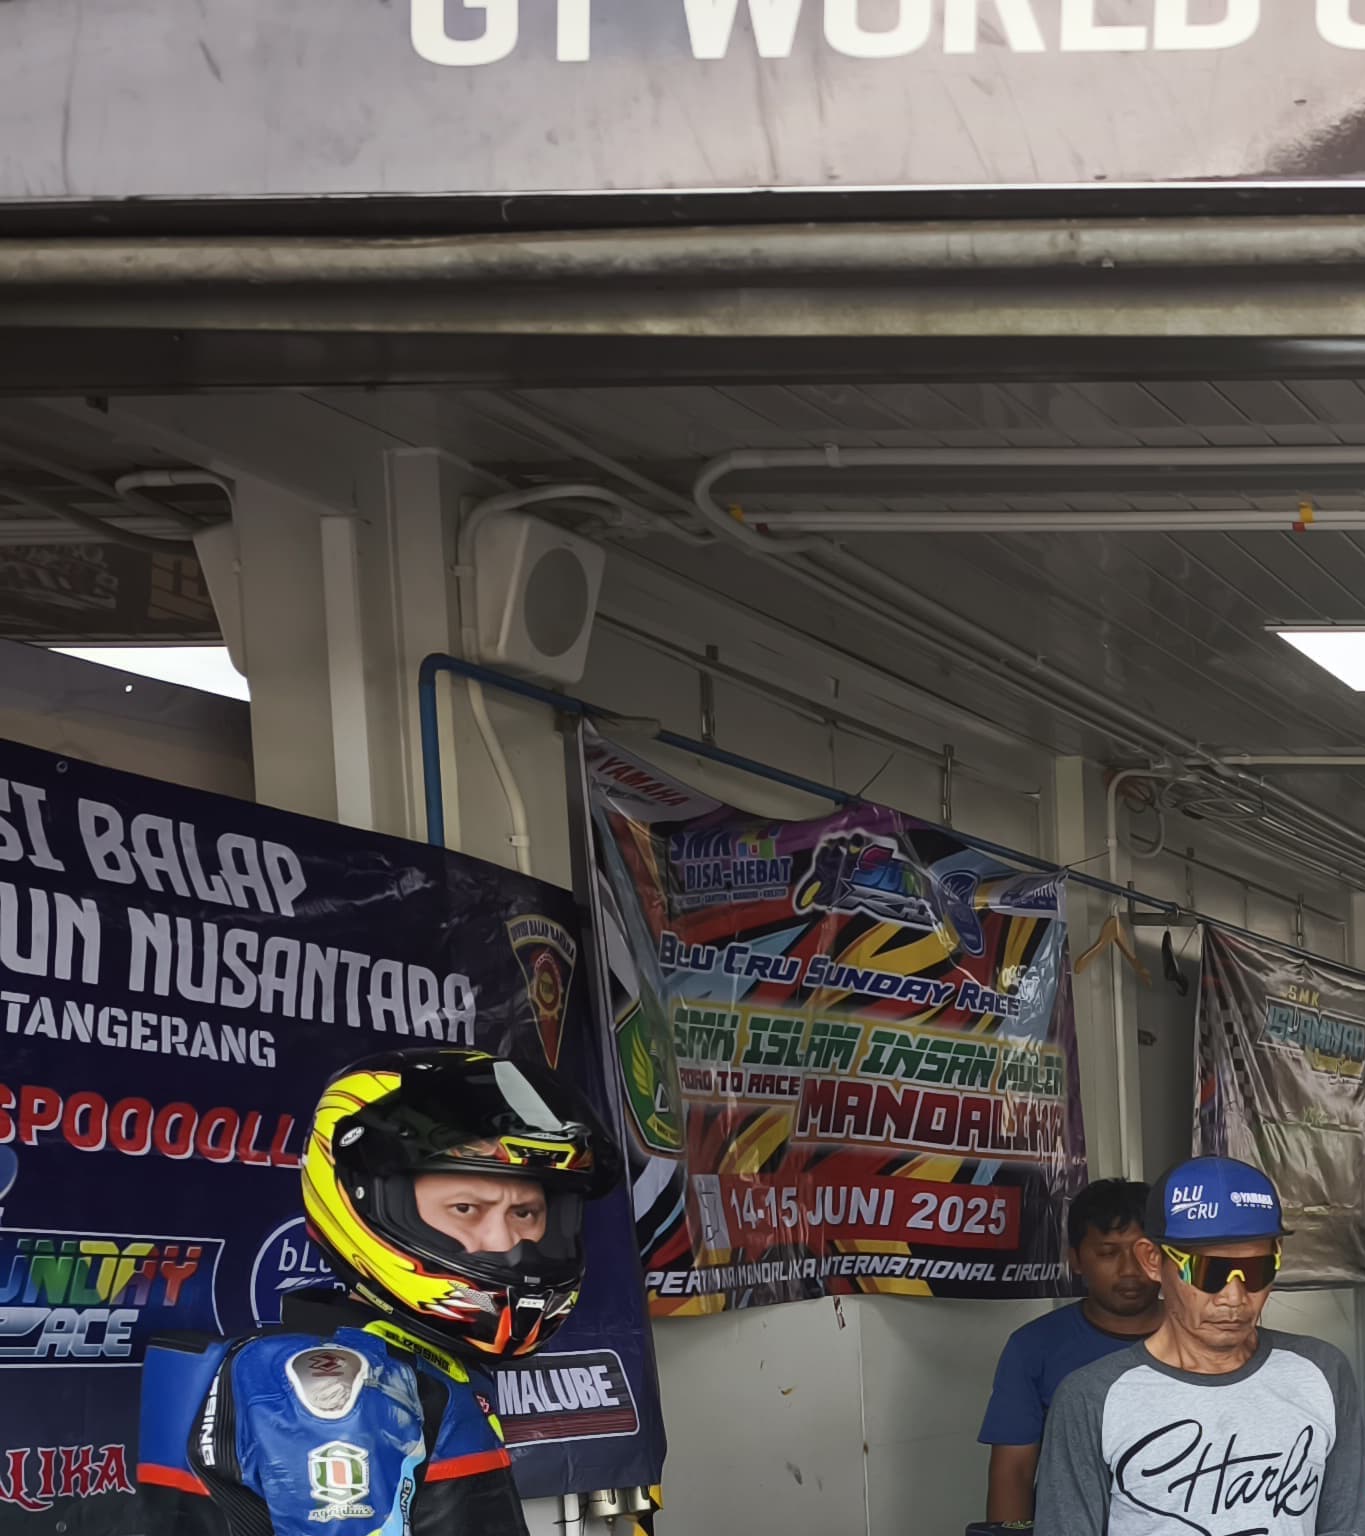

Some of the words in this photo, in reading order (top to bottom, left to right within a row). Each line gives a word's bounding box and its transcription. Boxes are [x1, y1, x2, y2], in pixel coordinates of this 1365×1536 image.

[596, 755, 692, 807] YAMAHA
[78, 797, 307, 917] BALAP
[127, 906, 476, 1046] NUSANTARA
[658, 931, 719, 971] BLU
[724, 944, 800, 985] CRU
[802, 956, 953, 1002] SUNDAY
[0, 992, 277, 1068] TANGERANG
[673, 1008, 738, 1064] SMK
[744, 1013, 862, 1072] ISLAM
[864, 1027, 998, 1091] INSAN
[718, 1069, 743, 1093] TO
[745, 1068, 801, 1098] RACE
[729, 1185, 799, 1230] 14-15
[806, 1185, 893, 1230] JUNI
[906, 1190, 1007, 1237] 2025
